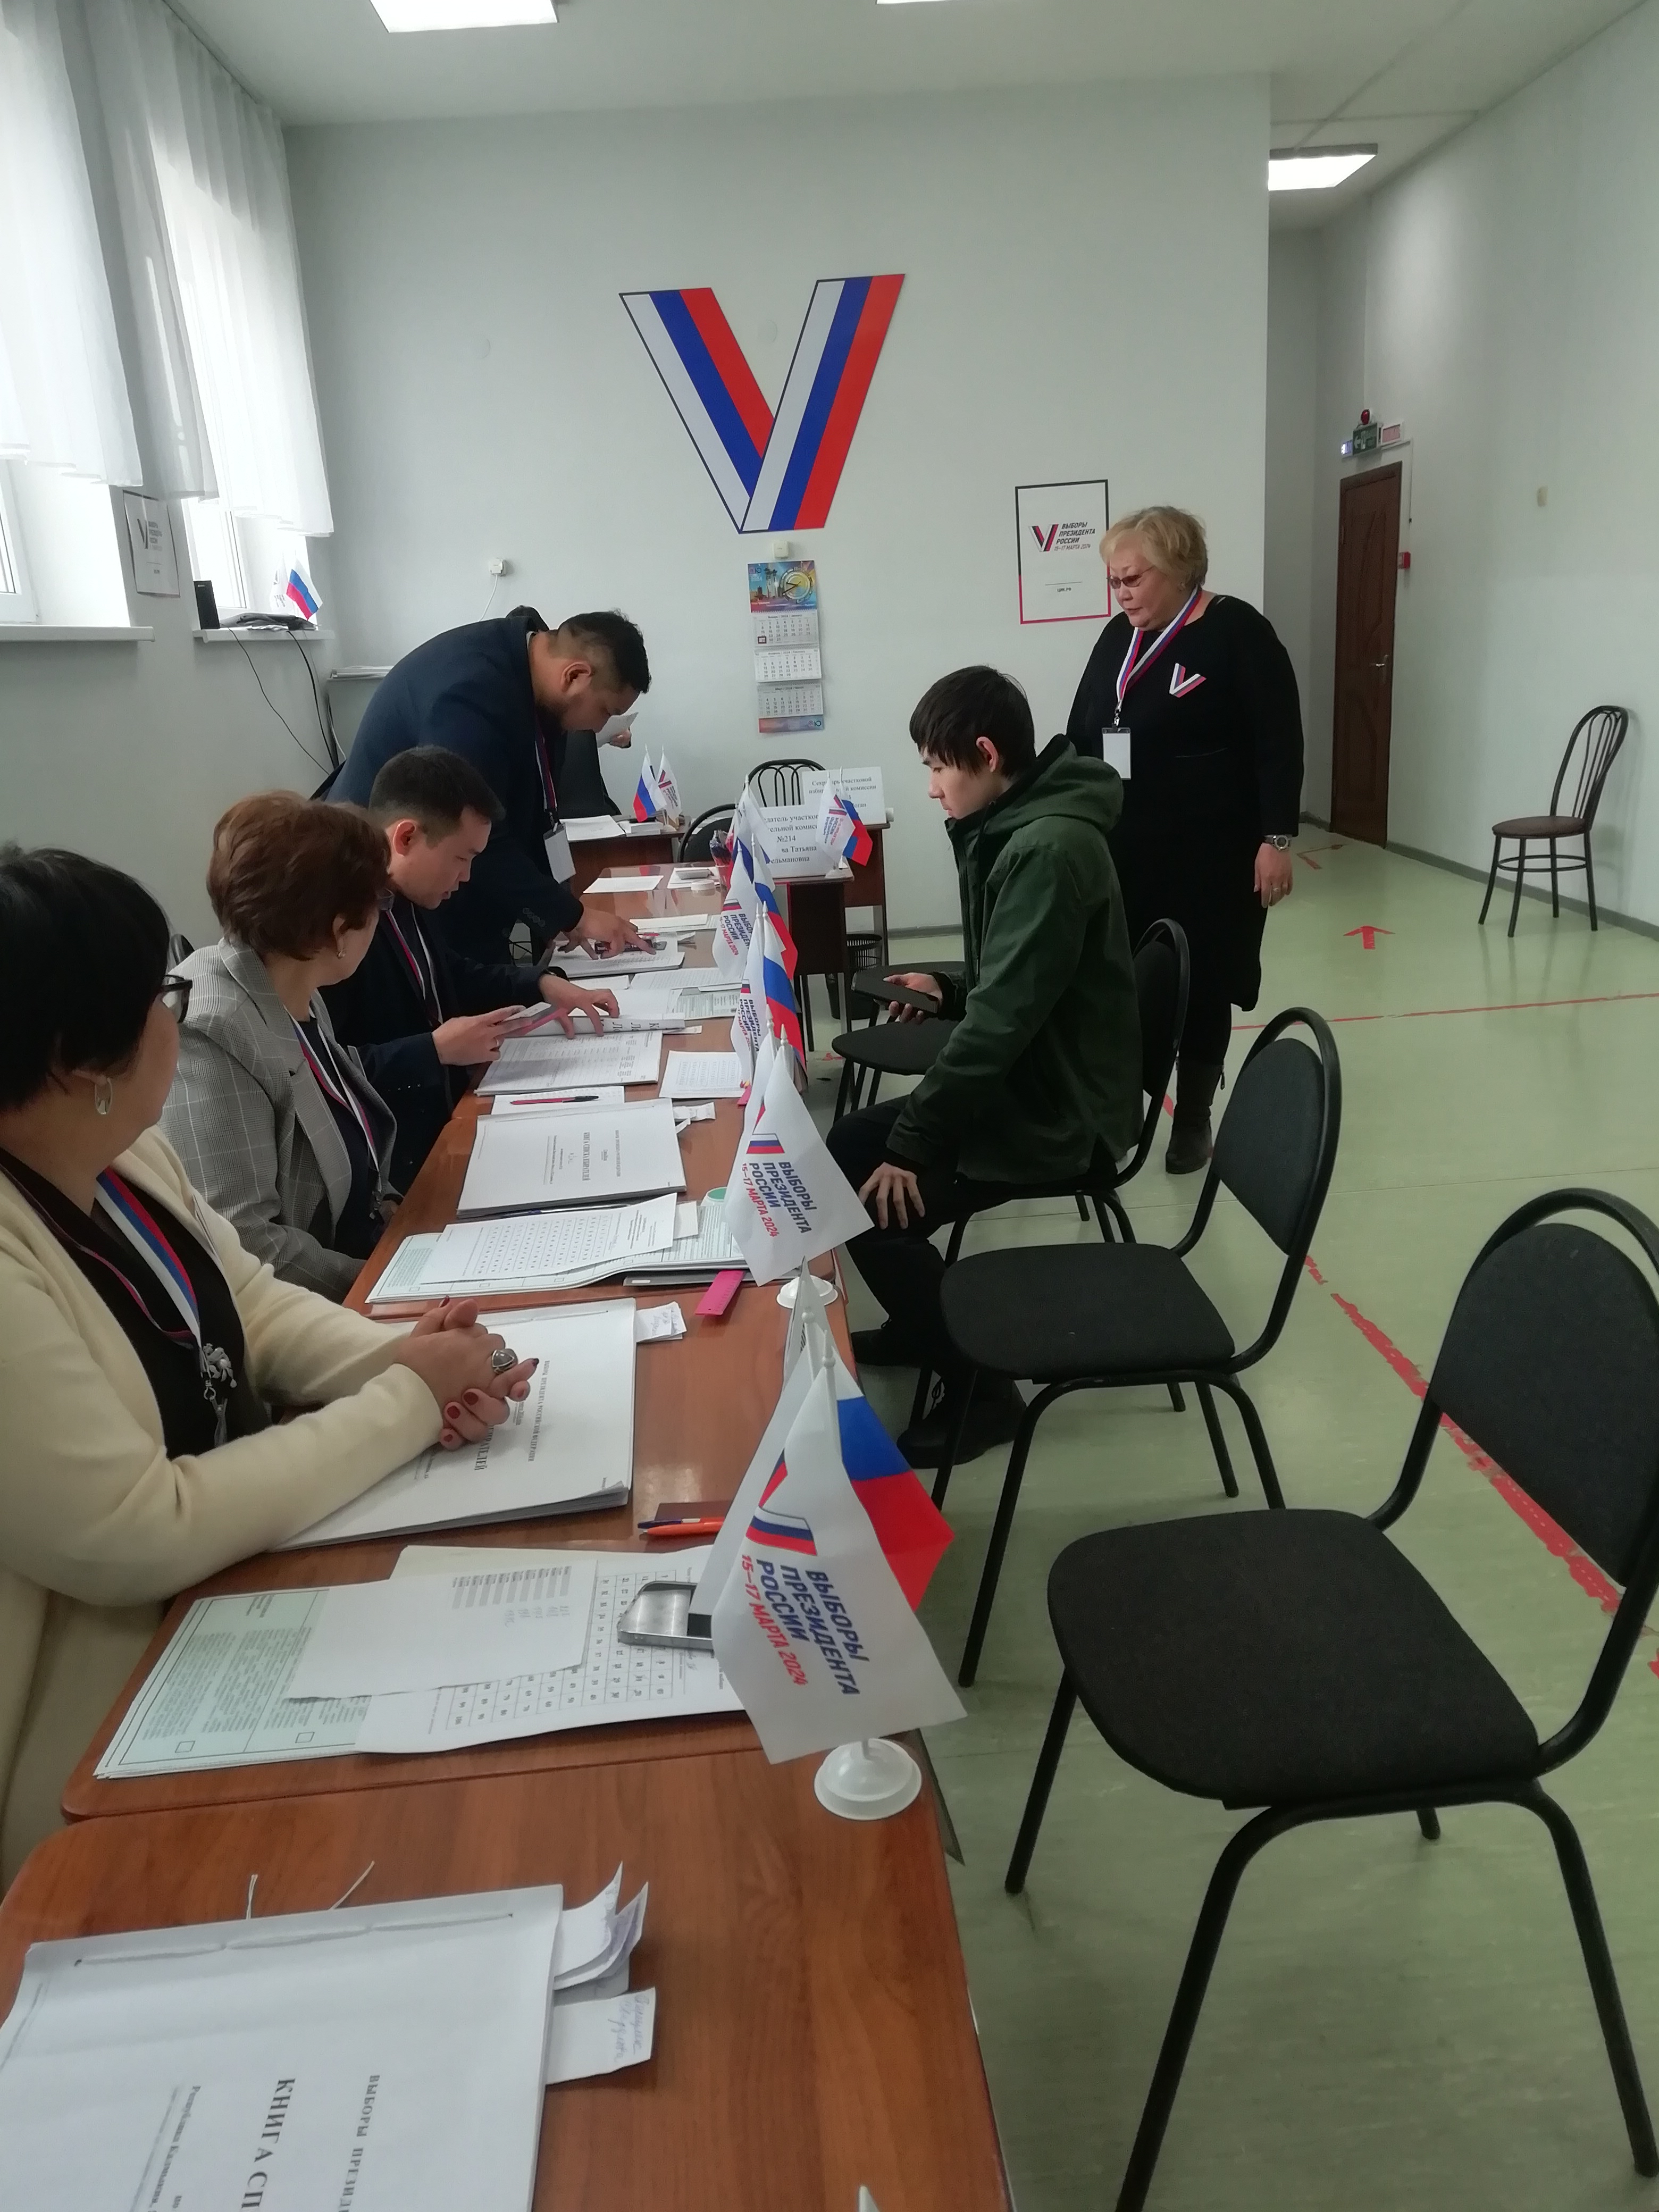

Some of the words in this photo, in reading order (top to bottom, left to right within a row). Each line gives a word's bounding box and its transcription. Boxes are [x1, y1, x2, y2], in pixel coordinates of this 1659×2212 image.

[1059, 529, 1095, 537] ПРЕЗИДЕНТА
[724, 916, 740, 940] РОССИИ
[740, 999, 751, 1031] РОССИИ
[743, 1000, 759, 1051] ПРЕЗИДЕНТА
[749, 1000, 761, 1036] ВЫБОРЫ
[749, 1163, 781, 1208] РОССИИ
[762, 1162, 812, 1233] ПРЕЗИДЕНТА
[778, 1162, 817, 1210] ВЫБОРЫ
[746, 1188, 768, 1215] МАРТА
[761, 1217, 780, 1237] 2024
[756, 1559, 810, 1642] РОССИИ
[805, 1570, 870, 1662] ВЫБОРЫ
[748, 1602, 790, 1648] МАРТА
[777, 1650, 808, 1685] 2024
[780, 1564, 860, 1695] ПРЕЗИДЕНТА
[254, 2077, 296, 2163] КНИГА
[356, 2074, 380, 2138] ВЫБОРЫ
